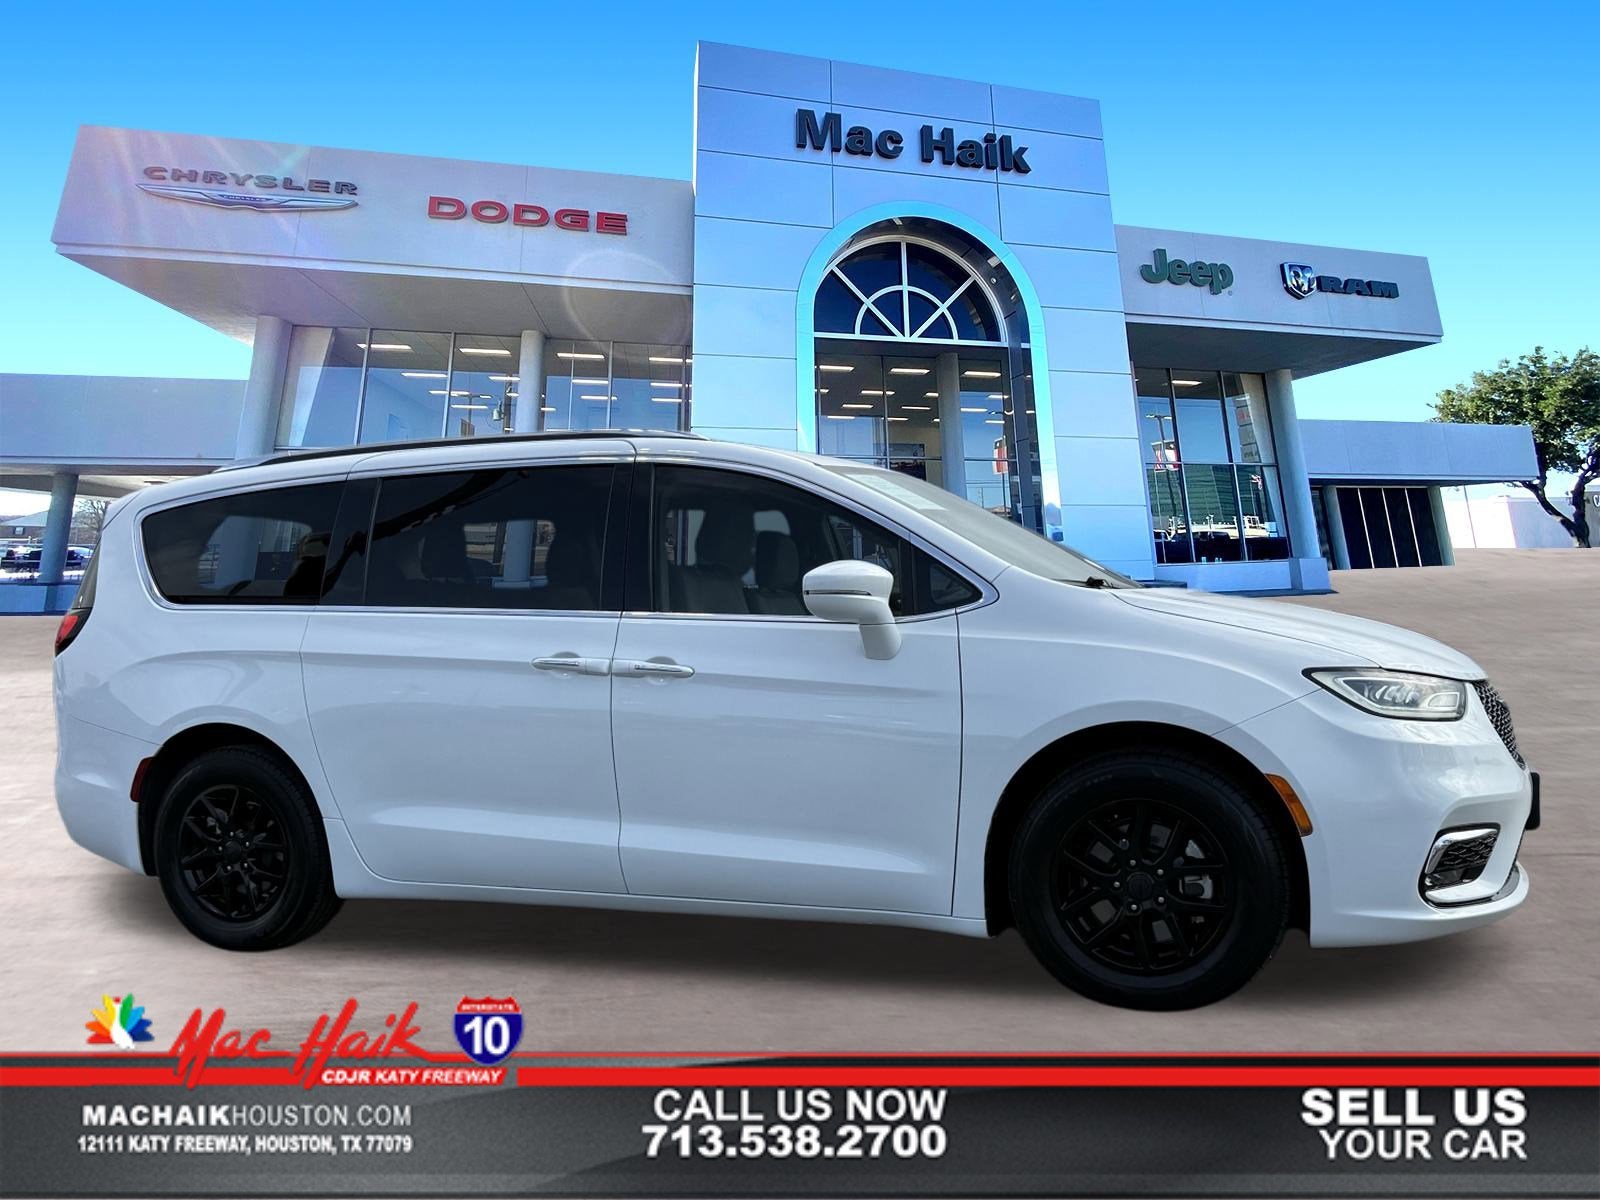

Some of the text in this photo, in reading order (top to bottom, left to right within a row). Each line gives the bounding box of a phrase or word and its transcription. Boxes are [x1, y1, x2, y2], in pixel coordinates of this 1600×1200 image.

[795, 108, 1032, 174] Mac Haik
[143, 166, 358, 196] CHRYSLER
[428, 195, 628, 236] DODGE
[1139, 248, 1234, 295] Jeep
[1315, 275, 1399, 299] RAM
